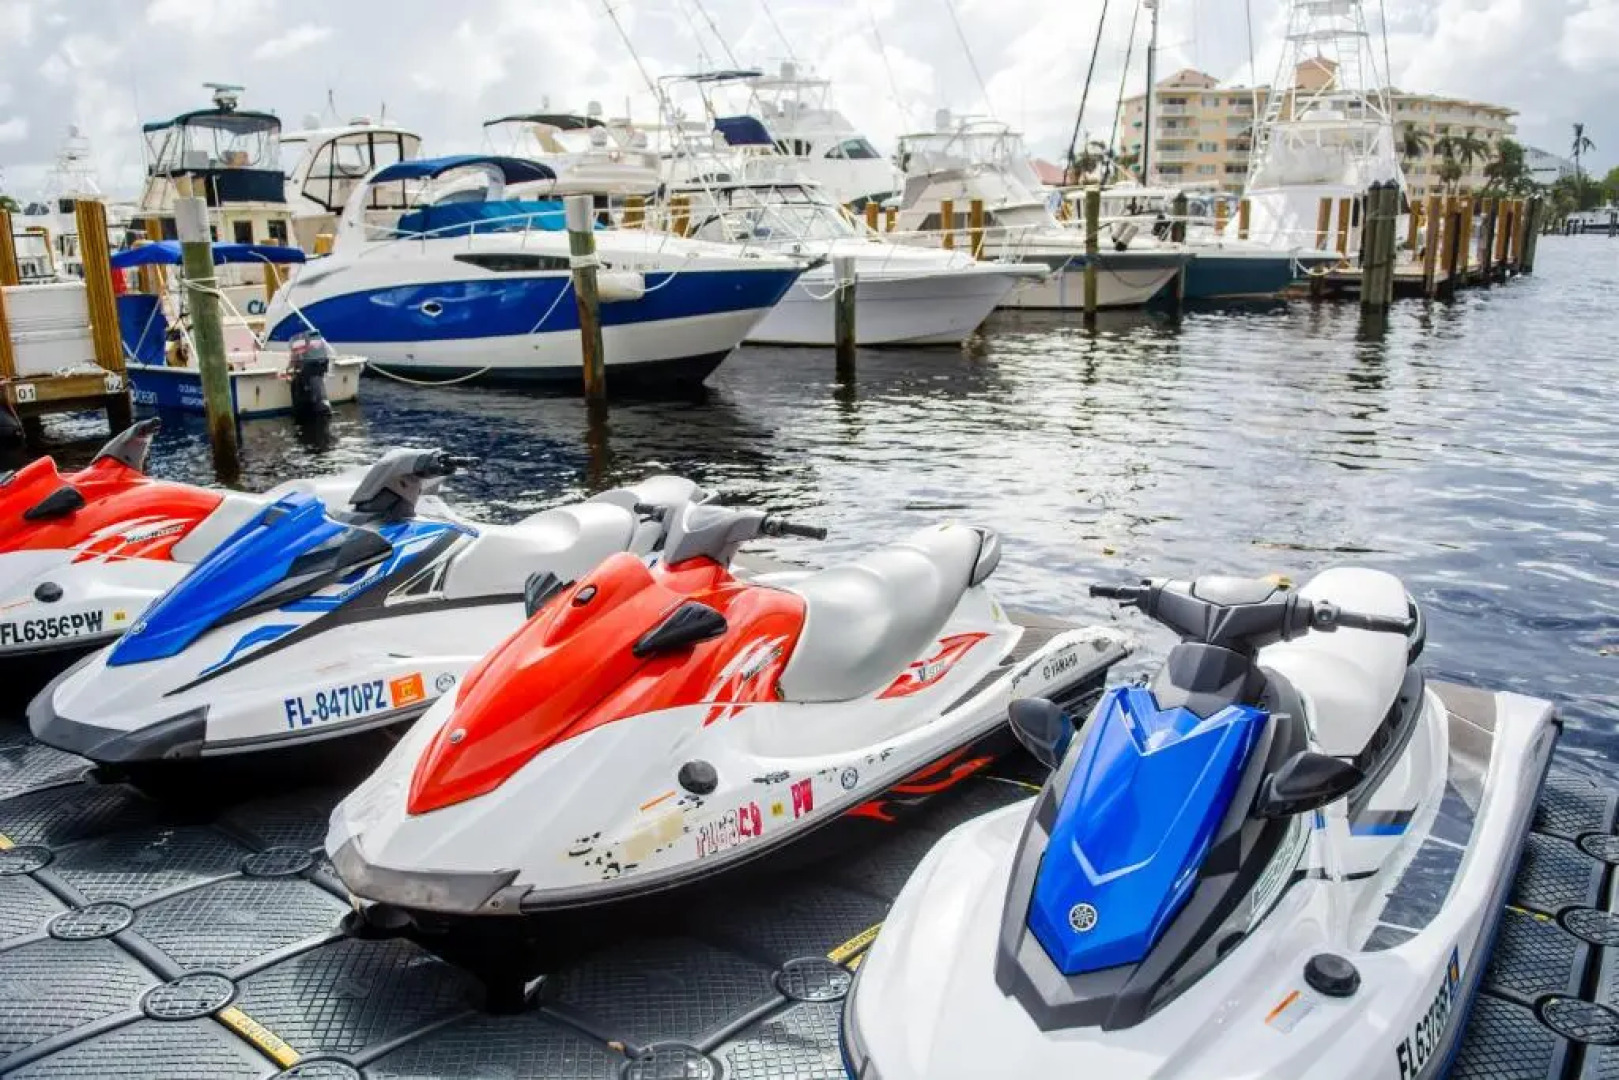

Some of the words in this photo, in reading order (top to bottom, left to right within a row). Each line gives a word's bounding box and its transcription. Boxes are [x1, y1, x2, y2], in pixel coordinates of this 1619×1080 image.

[18, 388, 34, 400] 01
[0, 609, 104, 645] FL6356PW
[284, 679, 387, 729] FL-8470PZ
